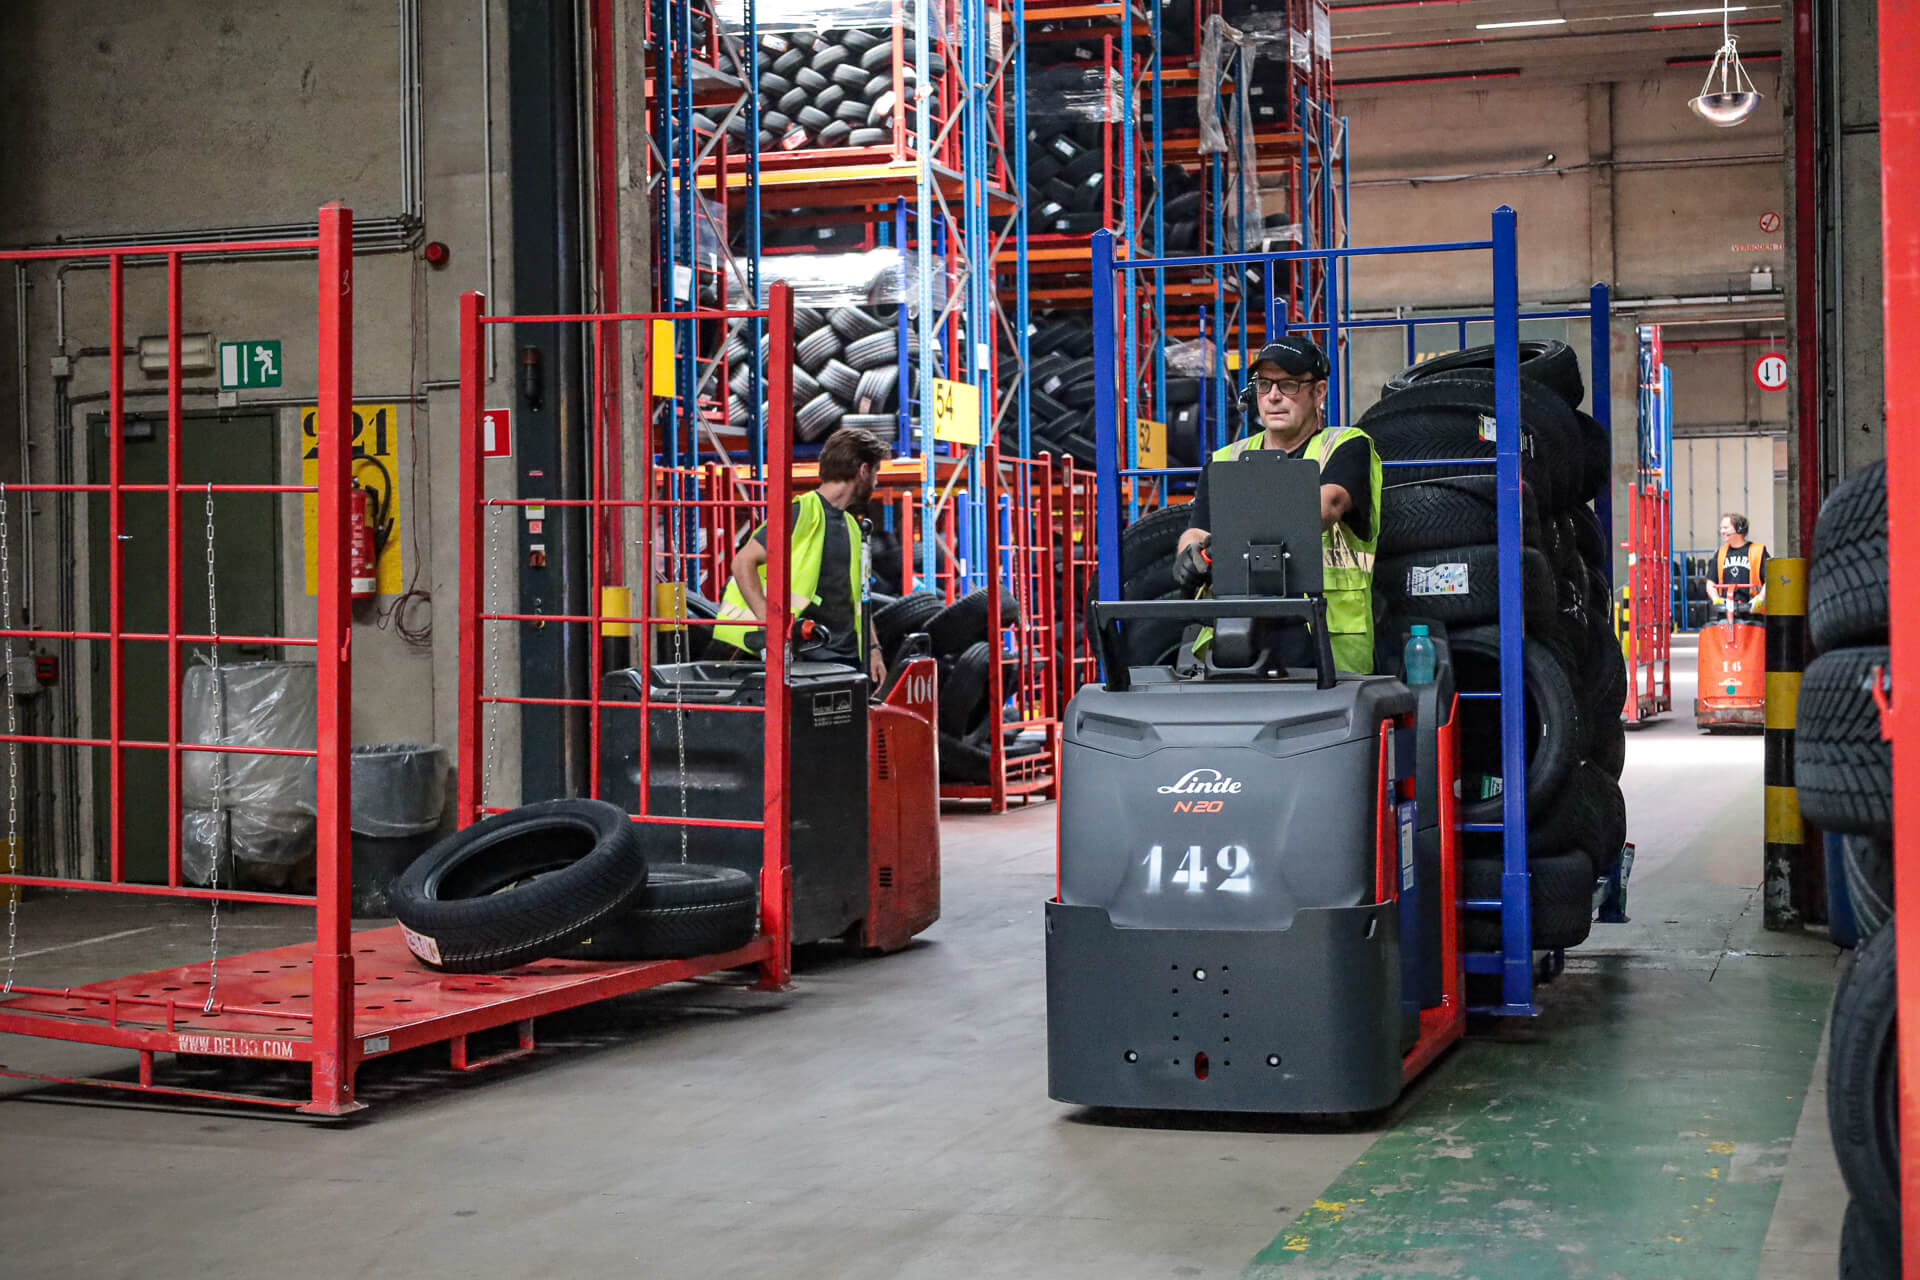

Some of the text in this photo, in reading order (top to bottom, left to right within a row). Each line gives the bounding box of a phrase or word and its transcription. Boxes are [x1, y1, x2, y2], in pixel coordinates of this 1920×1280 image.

[936, 383, 953, 420] 54
[1139, 422, 1151, 453] 52
[1723, 661, 1742, 673] 16
[1157, 768, 1242, 794] Linde
[1141, 844, 1251, 894] 142
